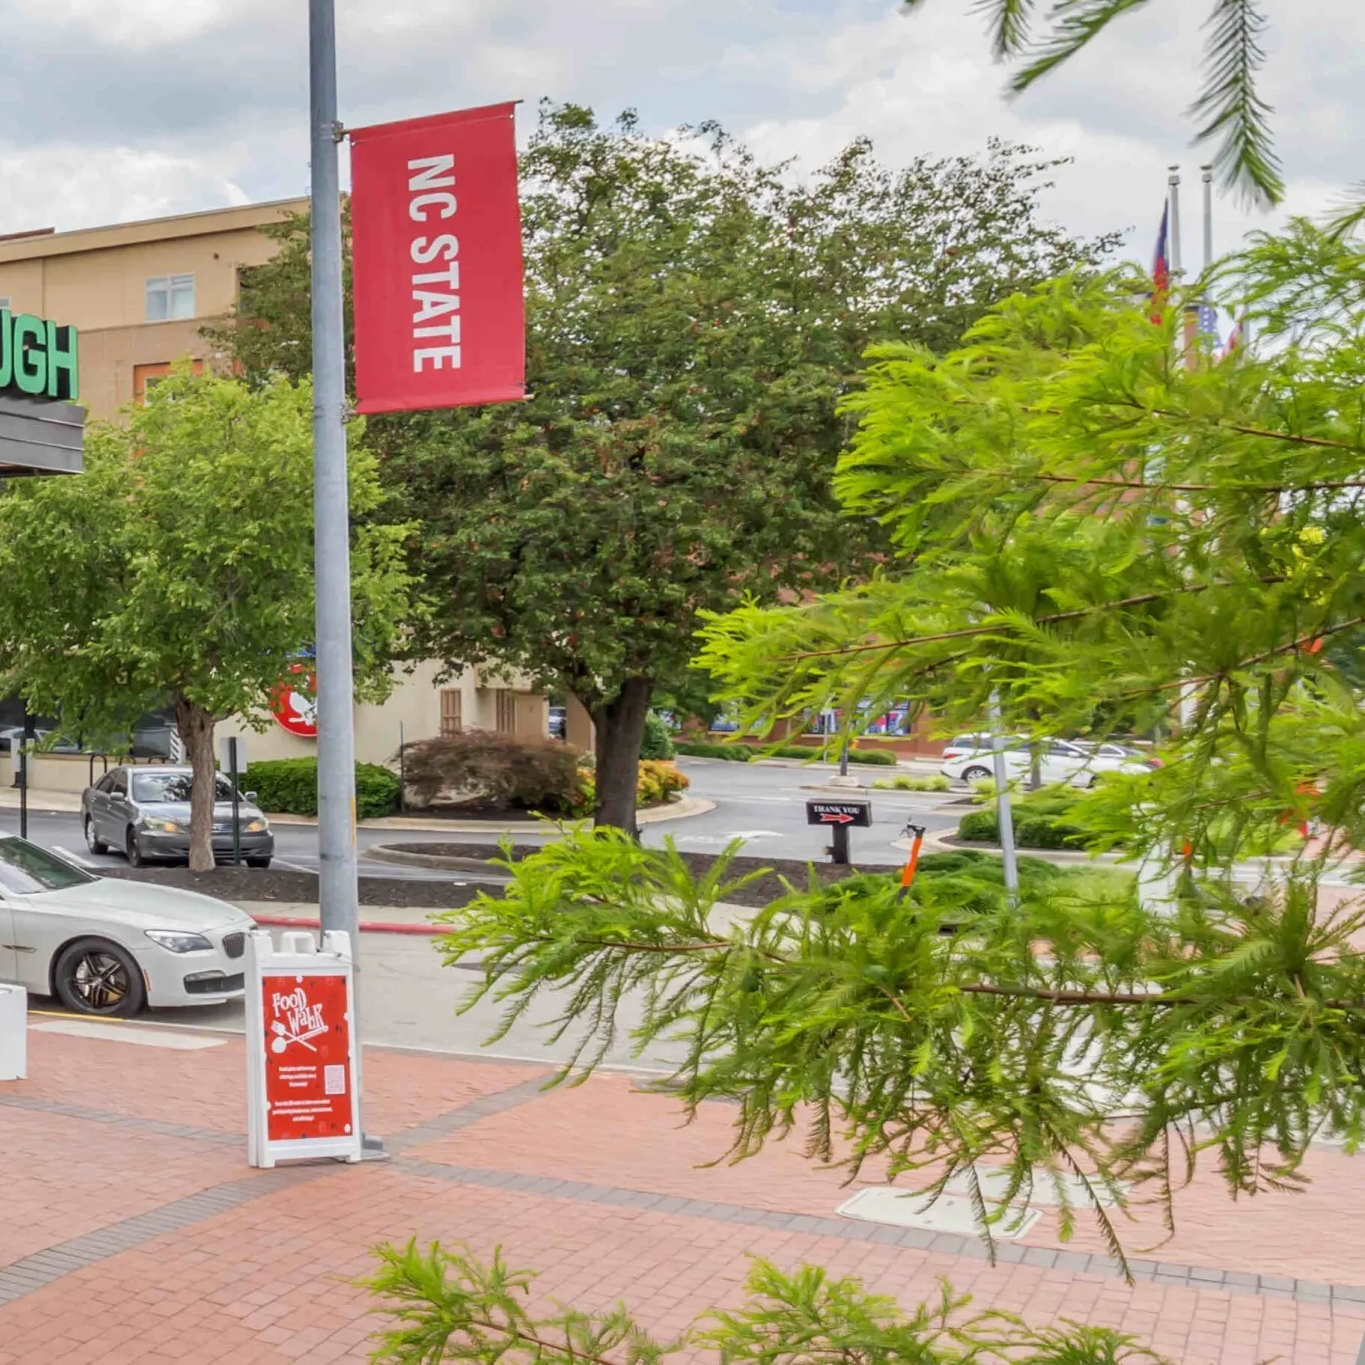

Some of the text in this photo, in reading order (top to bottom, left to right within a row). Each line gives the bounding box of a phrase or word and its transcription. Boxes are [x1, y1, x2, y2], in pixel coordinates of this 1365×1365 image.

[408, 153, 462, 373] NC STATE
[813, 805, 841, 813] THANK
